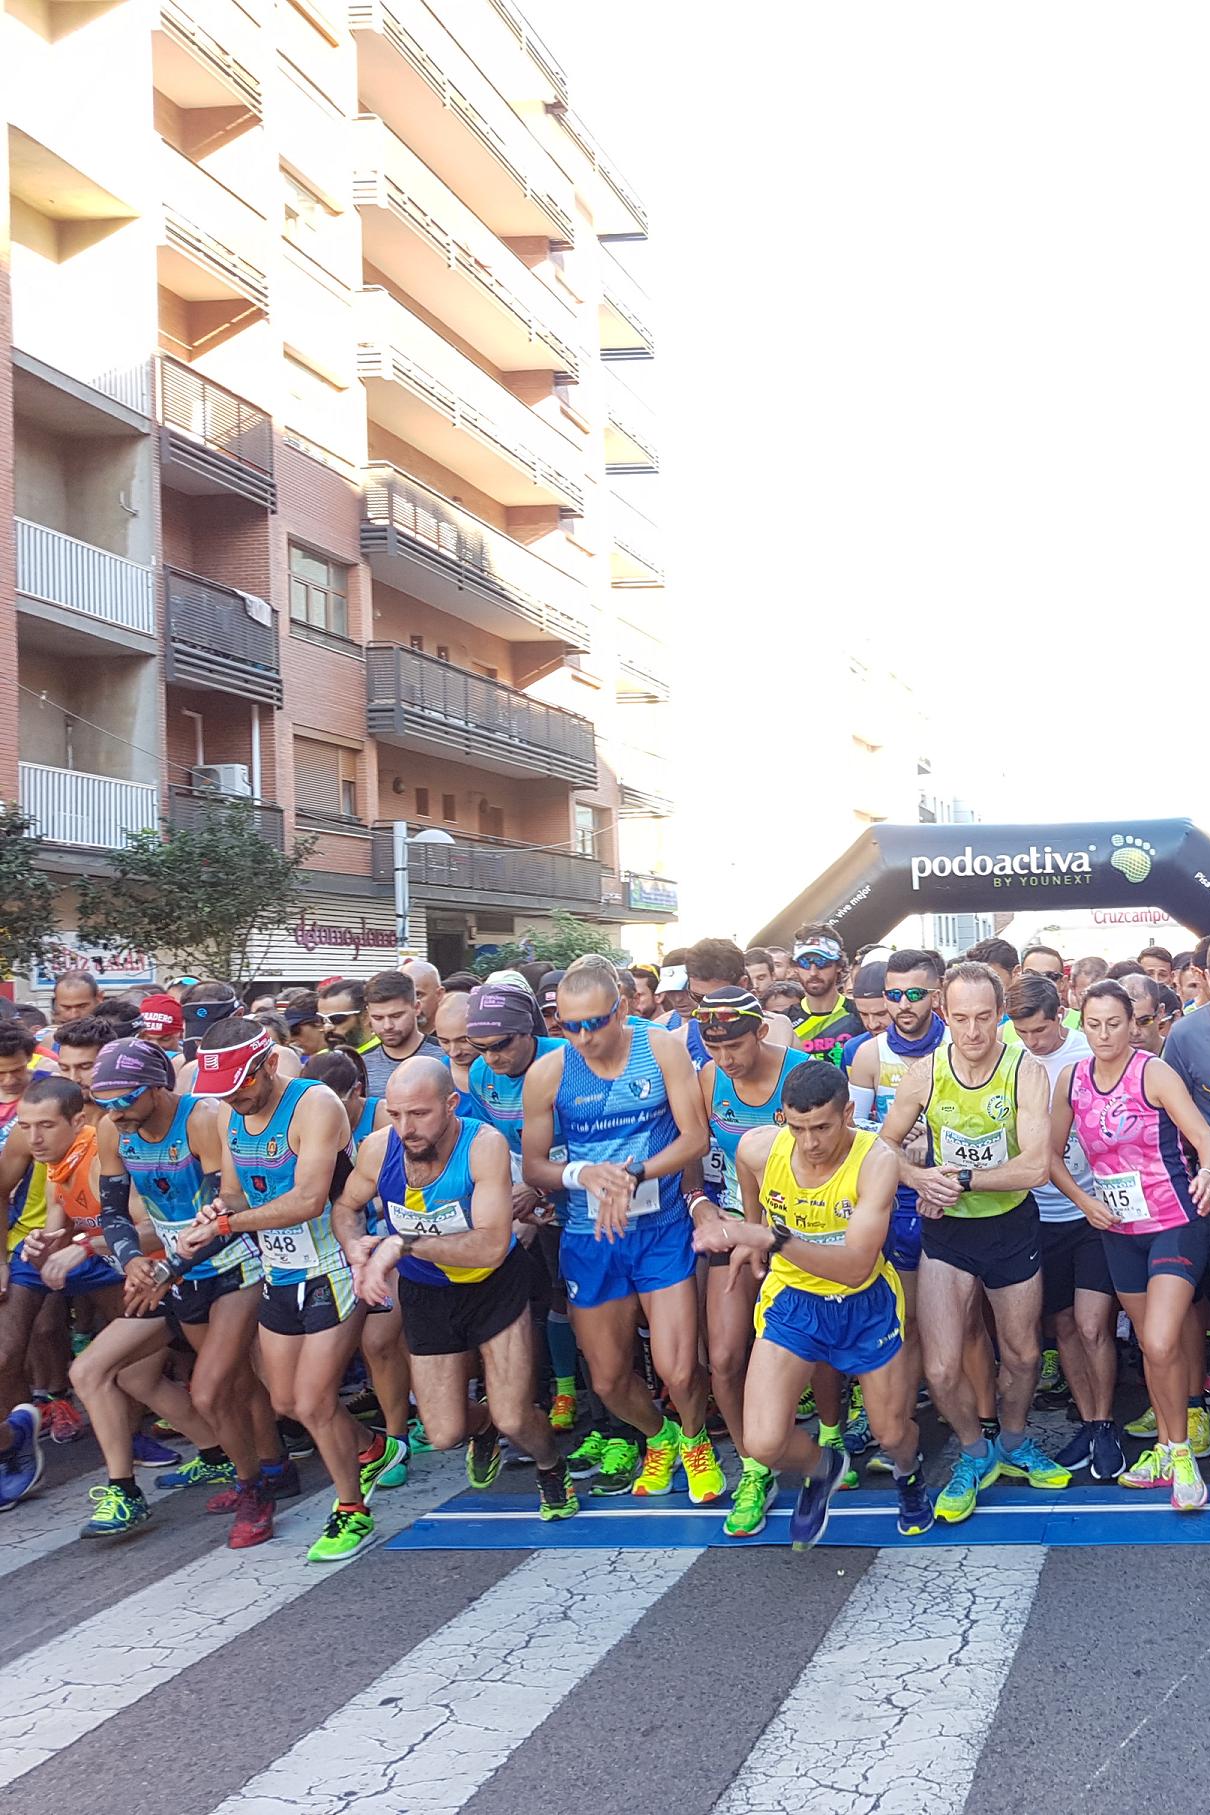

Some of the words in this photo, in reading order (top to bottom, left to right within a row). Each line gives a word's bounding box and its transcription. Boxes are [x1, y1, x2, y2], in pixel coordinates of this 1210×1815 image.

[911, 846, 1092, 890] podoactiva
[993, 878, 1013, 887] BY
[1020, 875, 1093, 887] YOUNEXT
[849, 885, 872, 906] mejor
[1093, 910, 1170, 925] Cruzcampo
[955, 1146, 993, 1162] 484
[263, 1234, 296, 1253] 548
